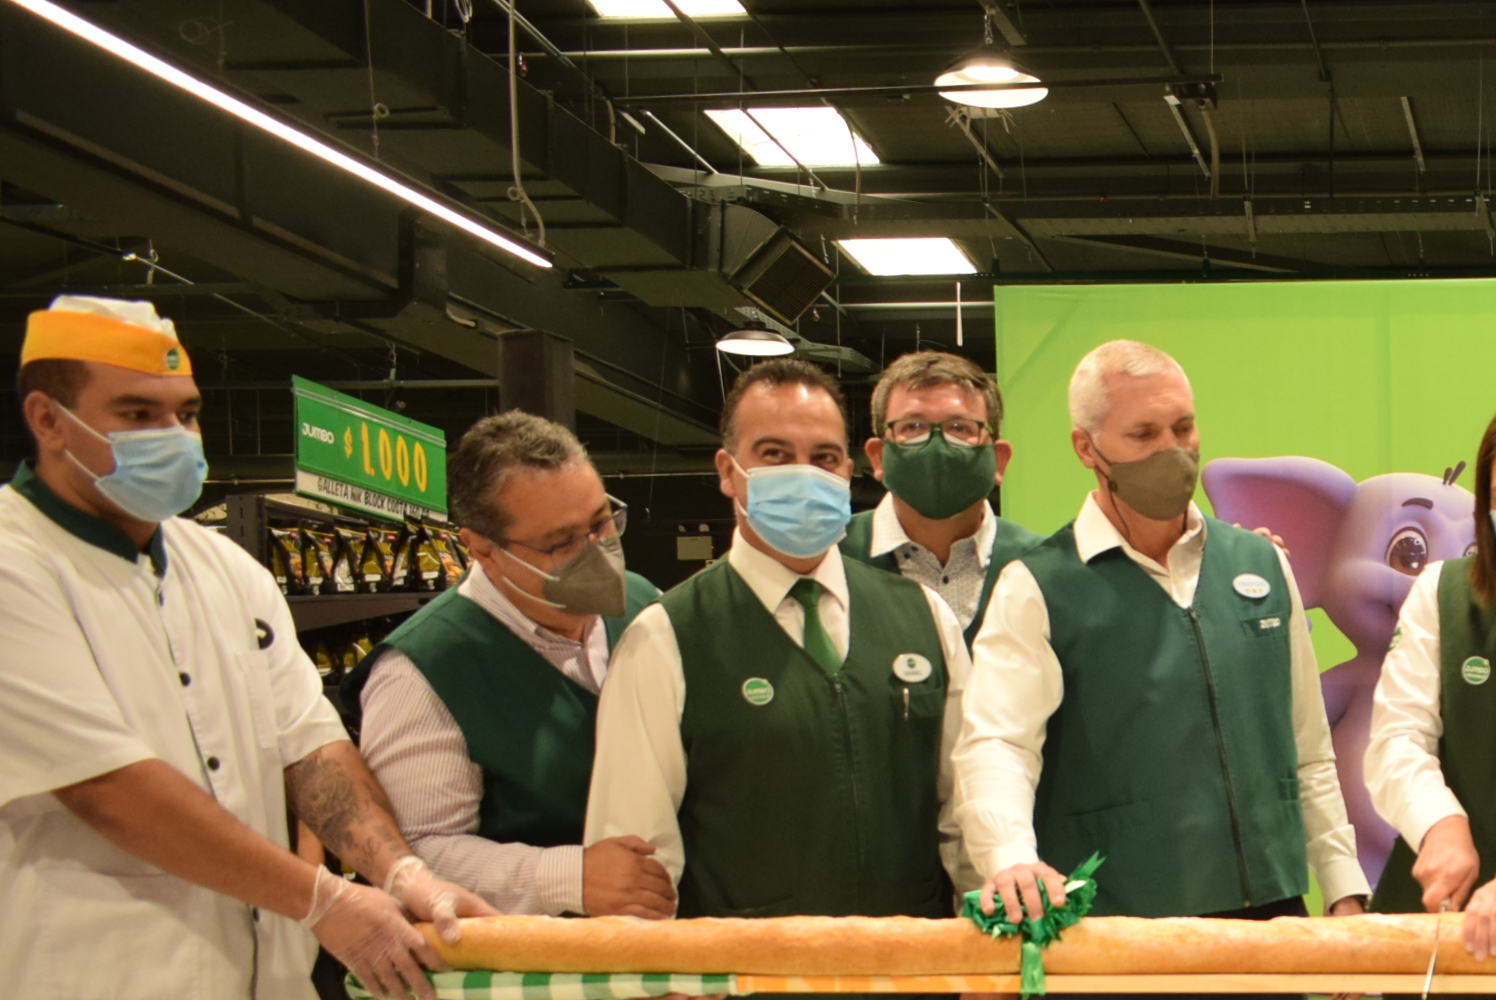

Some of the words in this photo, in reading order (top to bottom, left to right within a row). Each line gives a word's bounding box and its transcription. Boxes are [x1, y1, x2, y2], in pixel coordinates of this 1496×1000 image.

[302, 422, 335, 444] JUMBO
[317, 476, 349, 499] GALLETA
[364, 491, 385, 511] BLOCK
